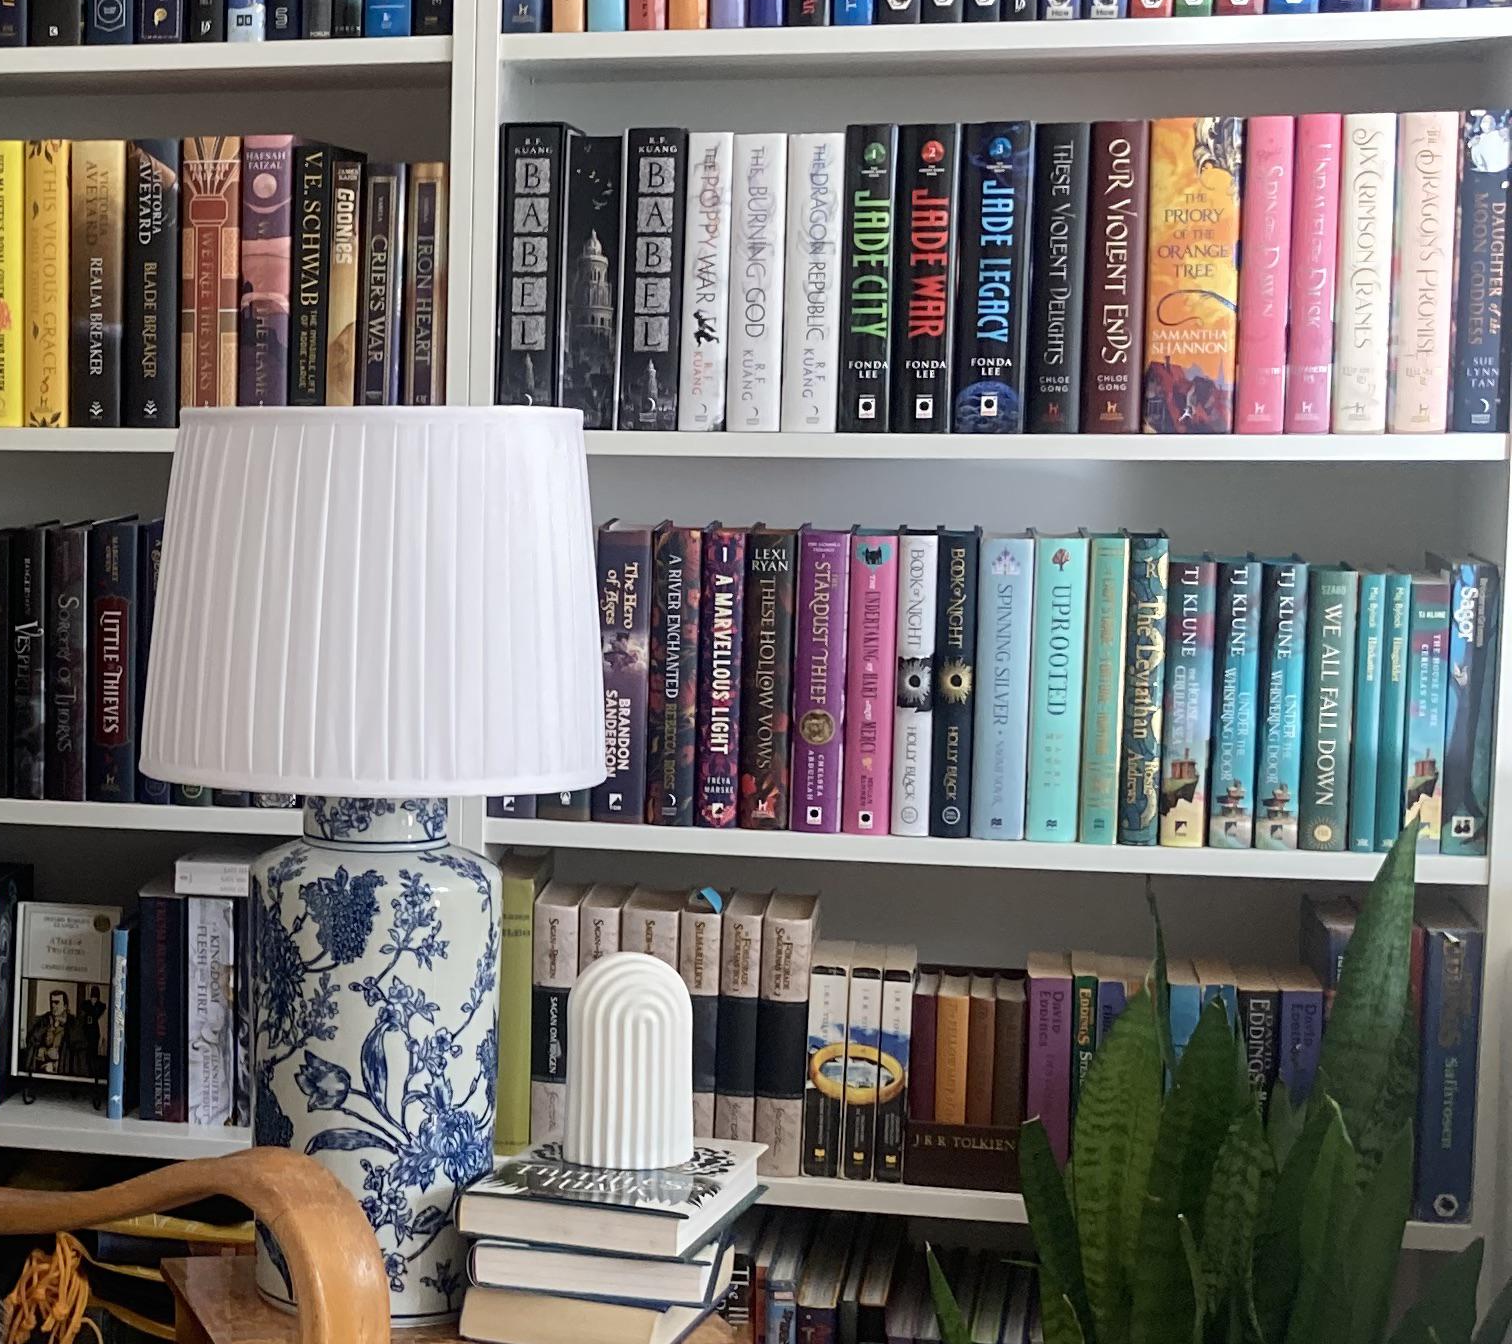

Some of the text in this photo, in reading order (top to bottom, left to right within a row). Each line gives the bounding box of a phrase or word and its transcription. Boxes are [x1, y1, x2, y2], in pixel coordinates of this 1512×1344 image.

[138, 156, 152, 245] AVEYARD
[300, 152, 322, 306] V. E. SCHWAB
[698, 176, 718, 248] POPPY
[1101, 138, 1136, 364] OUR VIOLENT ENDS
[368, 235, 387, 365] CRIER'S WAR
[521, 163, 542, 346] BABEL
[645, 163, 668, 348] BABEL
[695, 254, 715, 304] WAR
[850, 190, 891, 339] JADE CITY
[907, 188, 948, 339] JADE WAR
[976, 180, 1014, 343] JADE LEGACY
[142, 262, 157, 378] BLADE BREAKER
[970, 358, 1012, 367] FONDA
[981, 367, 1001, 376] LEE
[602, 569, 618, 626] of Ages
[623, 562, 638, 629] The Hero
[752, 560, 788, 571] RYAN
[755, 549, 786, 560] LEXI
[665, 555, 682, 698] A RIVER ENCHANTED
[710, 575, 733, 755] A MARVELLOUS LIGHT
[809, 562, 830, 704] STARDUST THIEF
[994, 584, 1013, 661] SPINNING
[1047, 584, 1072, 716] UPROOTED
[1277, 568, 1296, 659] TJ KLUNE
[1453, 586, 1478, 642] Sagor
[100, 610, 122, 733] LITTLE THIEVES
[755, 578, 776, 769] THESE HOLLOW VOWS
[993, 666, 1011, 726] SILVER
[1315, 604, 1343, 805] WE ALL FALL DOWN
[605, 689, 618, 778] SANDERSON
[617, 698, 631, 770] BRANDON
[953, 1135, 1016, 1152] TOLKIEN
